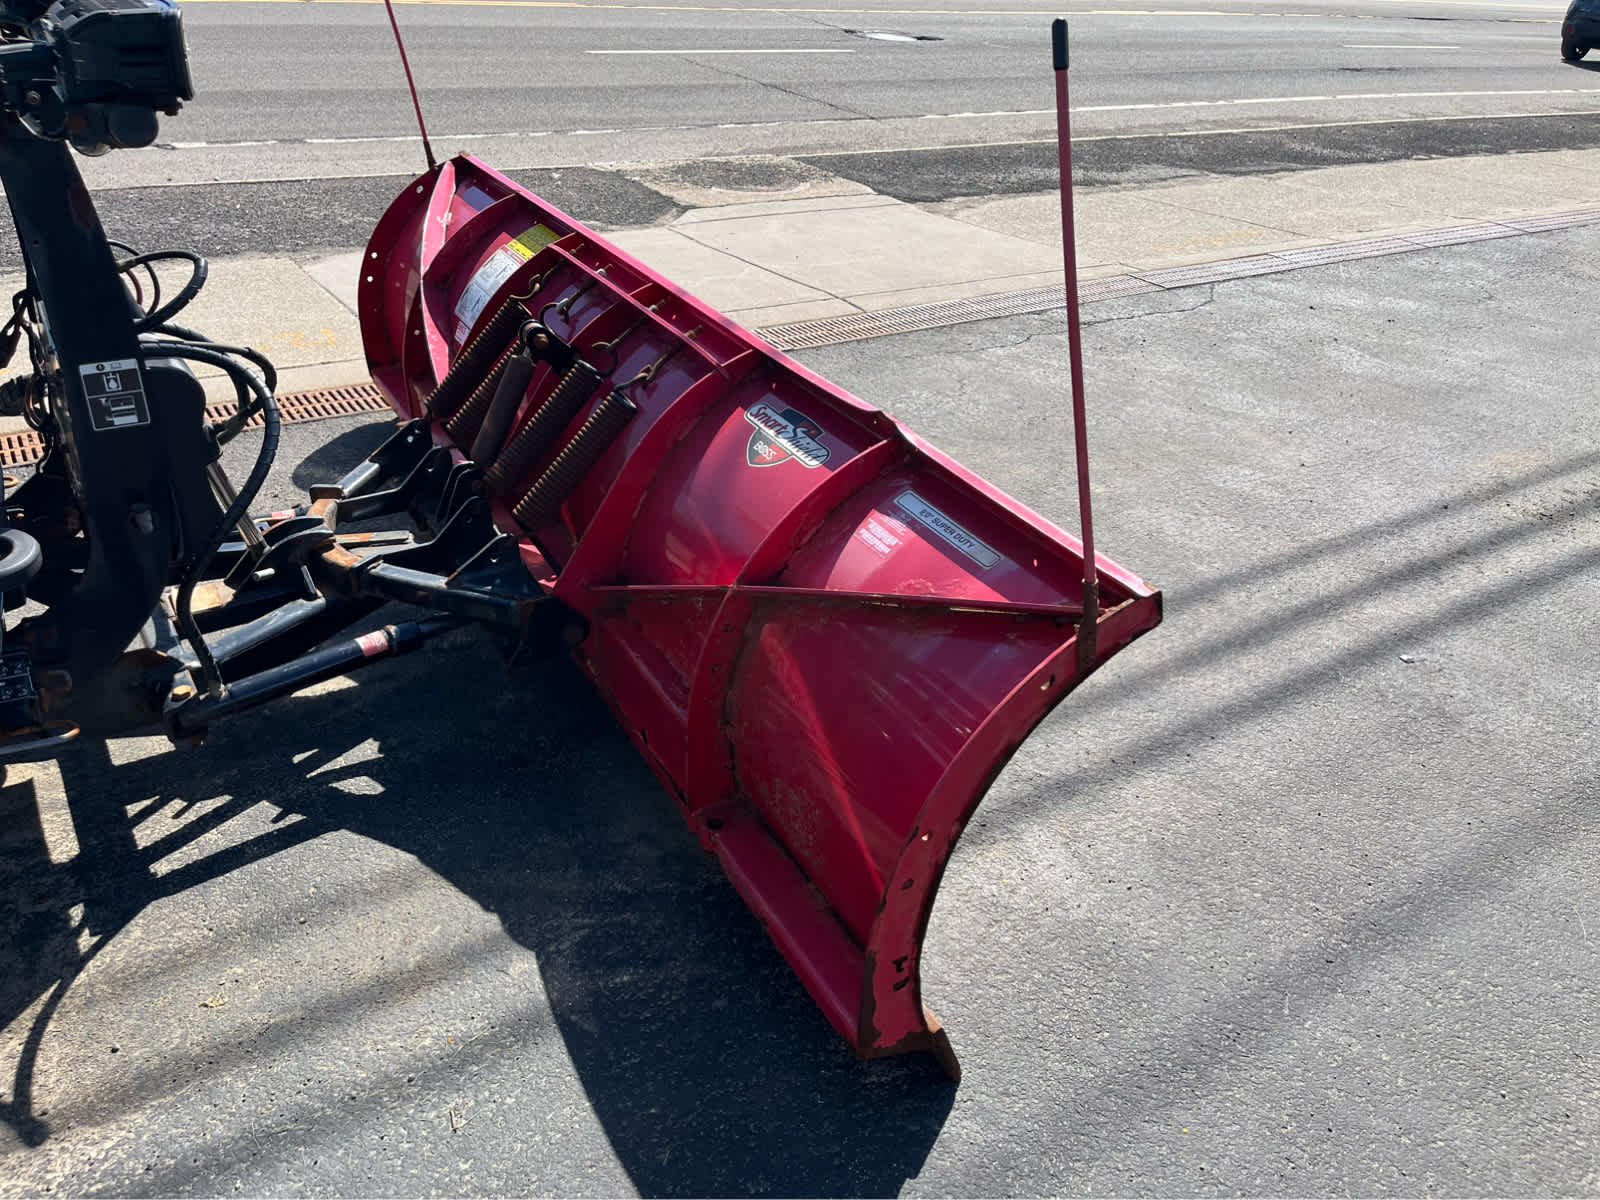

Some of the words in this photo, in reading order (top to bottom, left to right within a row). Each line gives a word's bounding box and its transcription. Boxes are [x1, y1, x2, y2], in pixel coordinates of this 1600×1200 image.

[753, 441, 776, 460] BOSS
[932, 516, 955, 536] SUPER
[953, 532, 975, 549] DUTY
